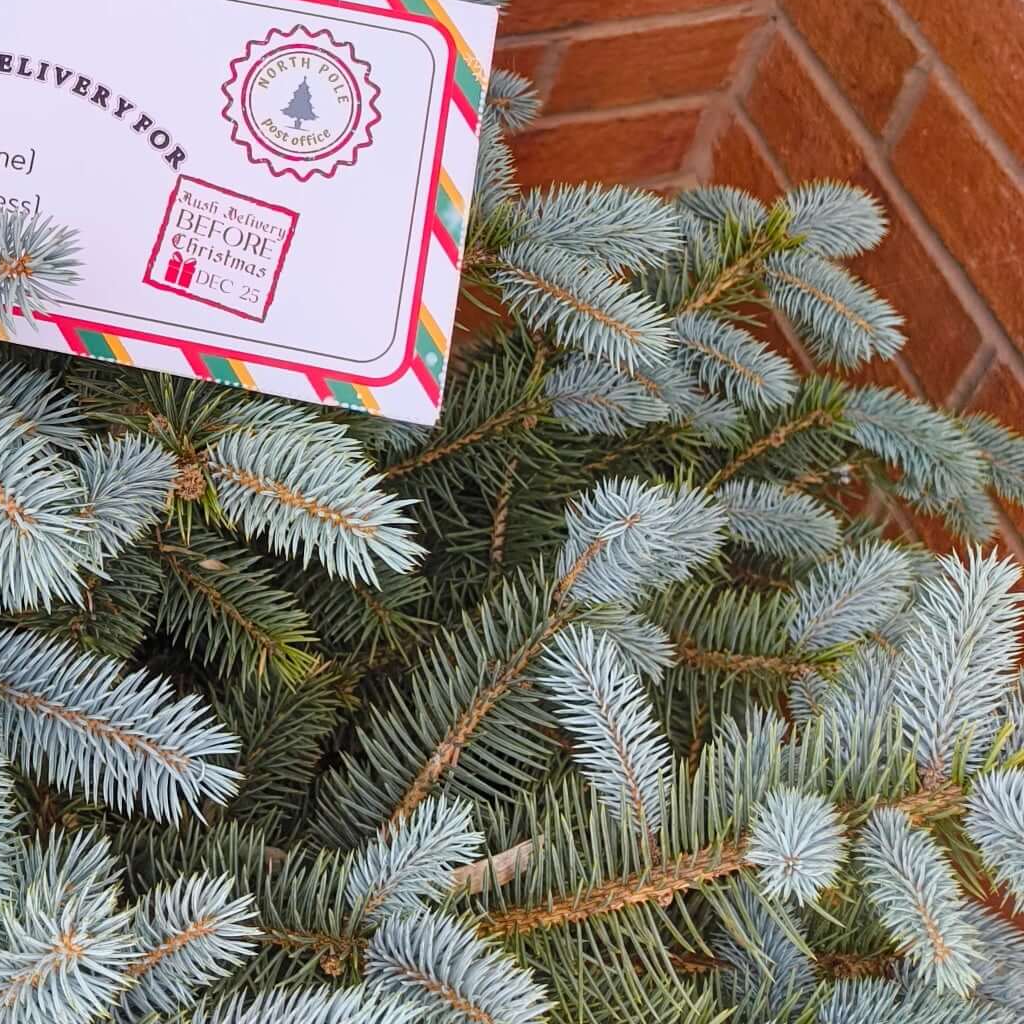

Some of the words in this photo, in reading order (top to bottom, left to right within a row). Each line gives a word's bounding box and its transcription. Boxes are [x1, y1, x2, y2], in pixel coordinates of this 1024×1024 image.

[257, 57, 312, 89] NORTH
[318, 64, 350, 105] POLE
[131, 113, 187, 170] FOR
[261, 118, 290, 142] post
[291, 128, 332, 147] office
[176, 208, 276, 260] BEFORE
[178, 190, 219, 215] Rush
[223, 206, 287, 242] Delivery
[171, 233, 267, 278] Christmas
[195, 269, 234, 294] DEC
[239, 285, 261, 304] 25
